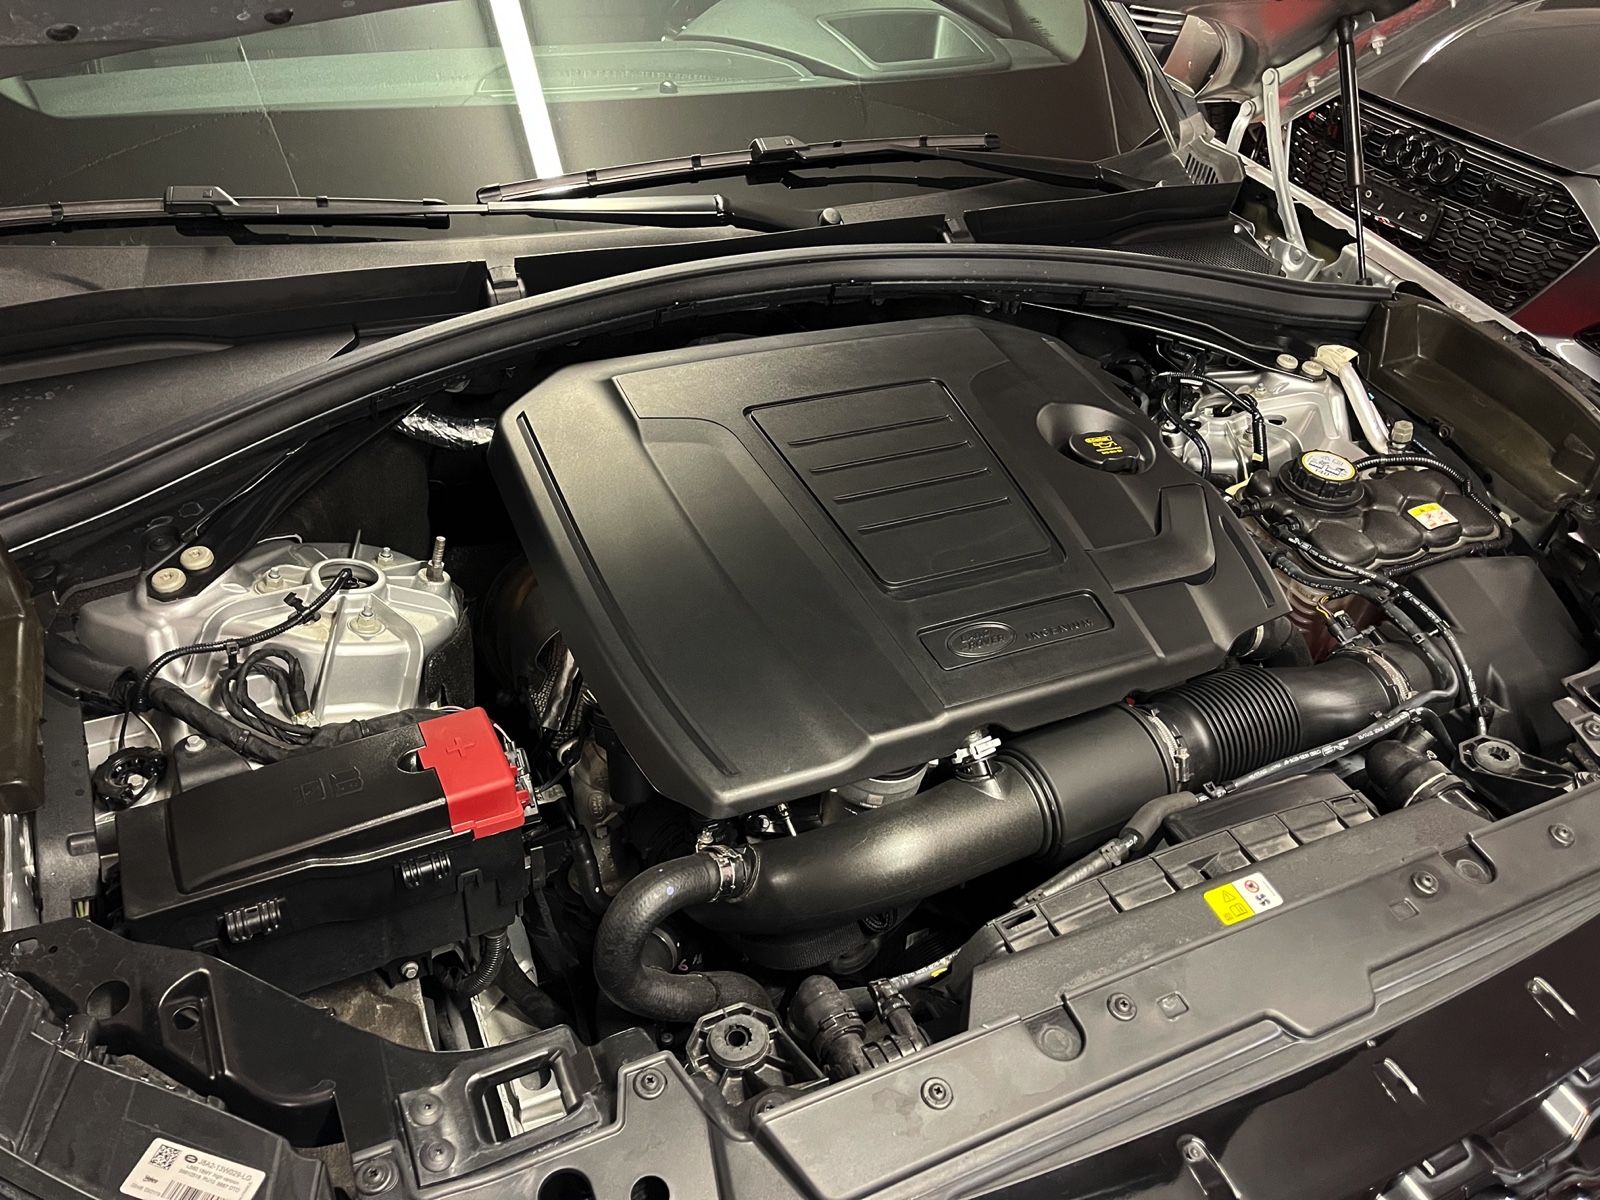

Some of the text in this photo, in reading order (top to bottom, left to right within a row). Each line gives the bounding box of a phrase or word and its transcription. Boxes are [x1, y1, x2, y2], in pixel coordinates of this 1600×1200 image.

[960, 629, 990, 643] LAND
[1025, 619, 1094, 641] INGENIUM
[967, 635, 1005, 650] ROVER
